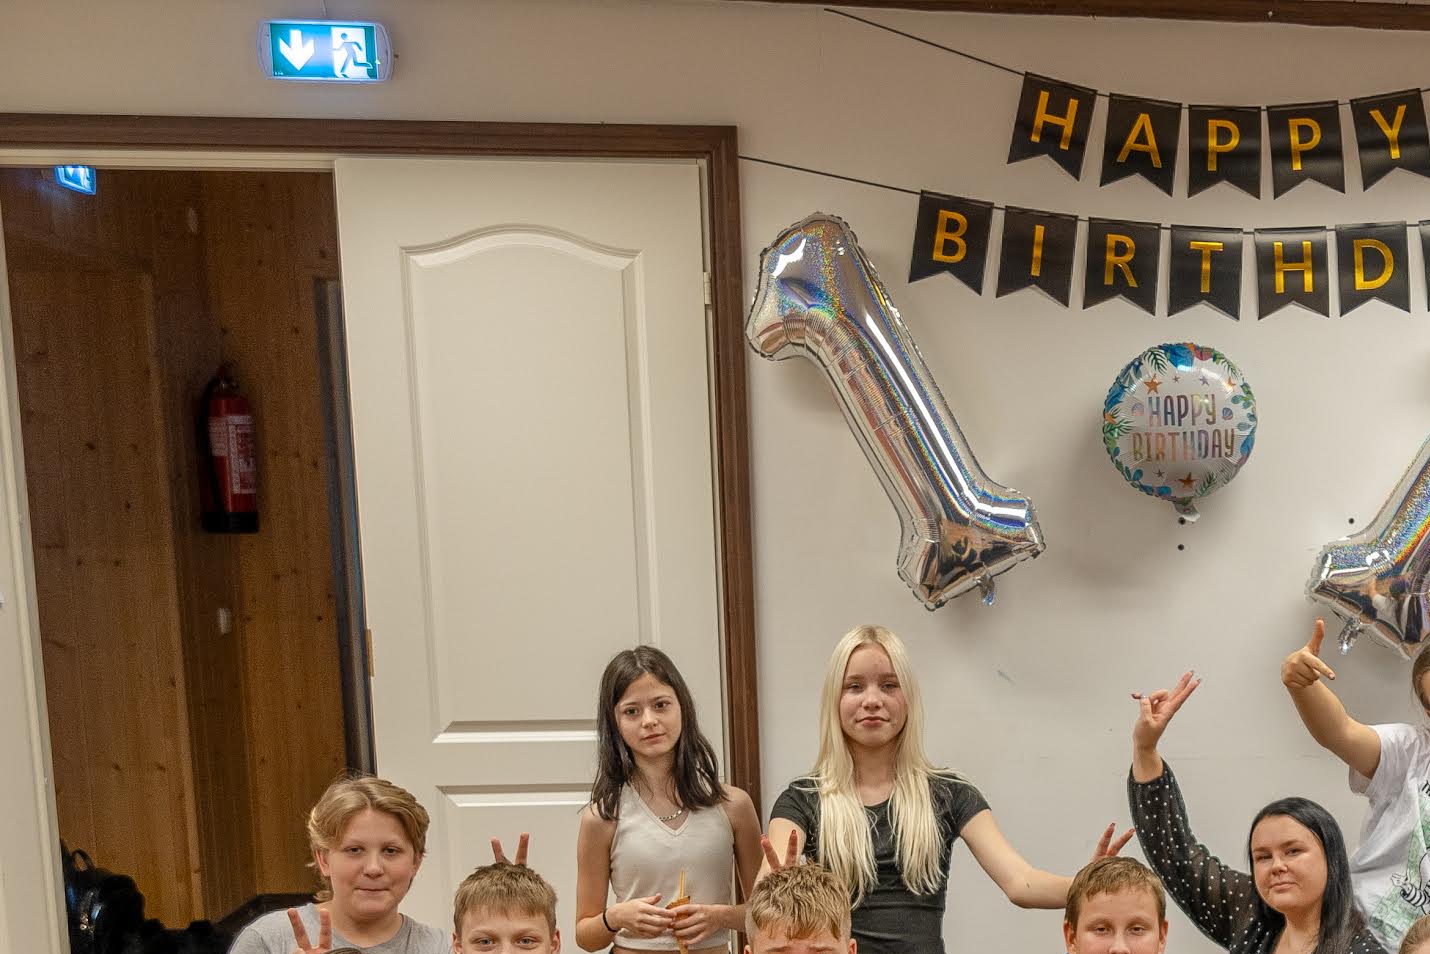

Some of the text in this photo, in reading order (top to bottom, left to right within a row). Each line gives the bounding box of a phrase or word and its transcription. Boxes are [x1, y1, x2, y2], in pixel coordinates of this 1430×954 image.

[1028, 90, 1408, 171] HAPPY
[1148, 394, 1216, 427] HAPPY
[1132, 428, 1235, 463] BIRTHDAY
